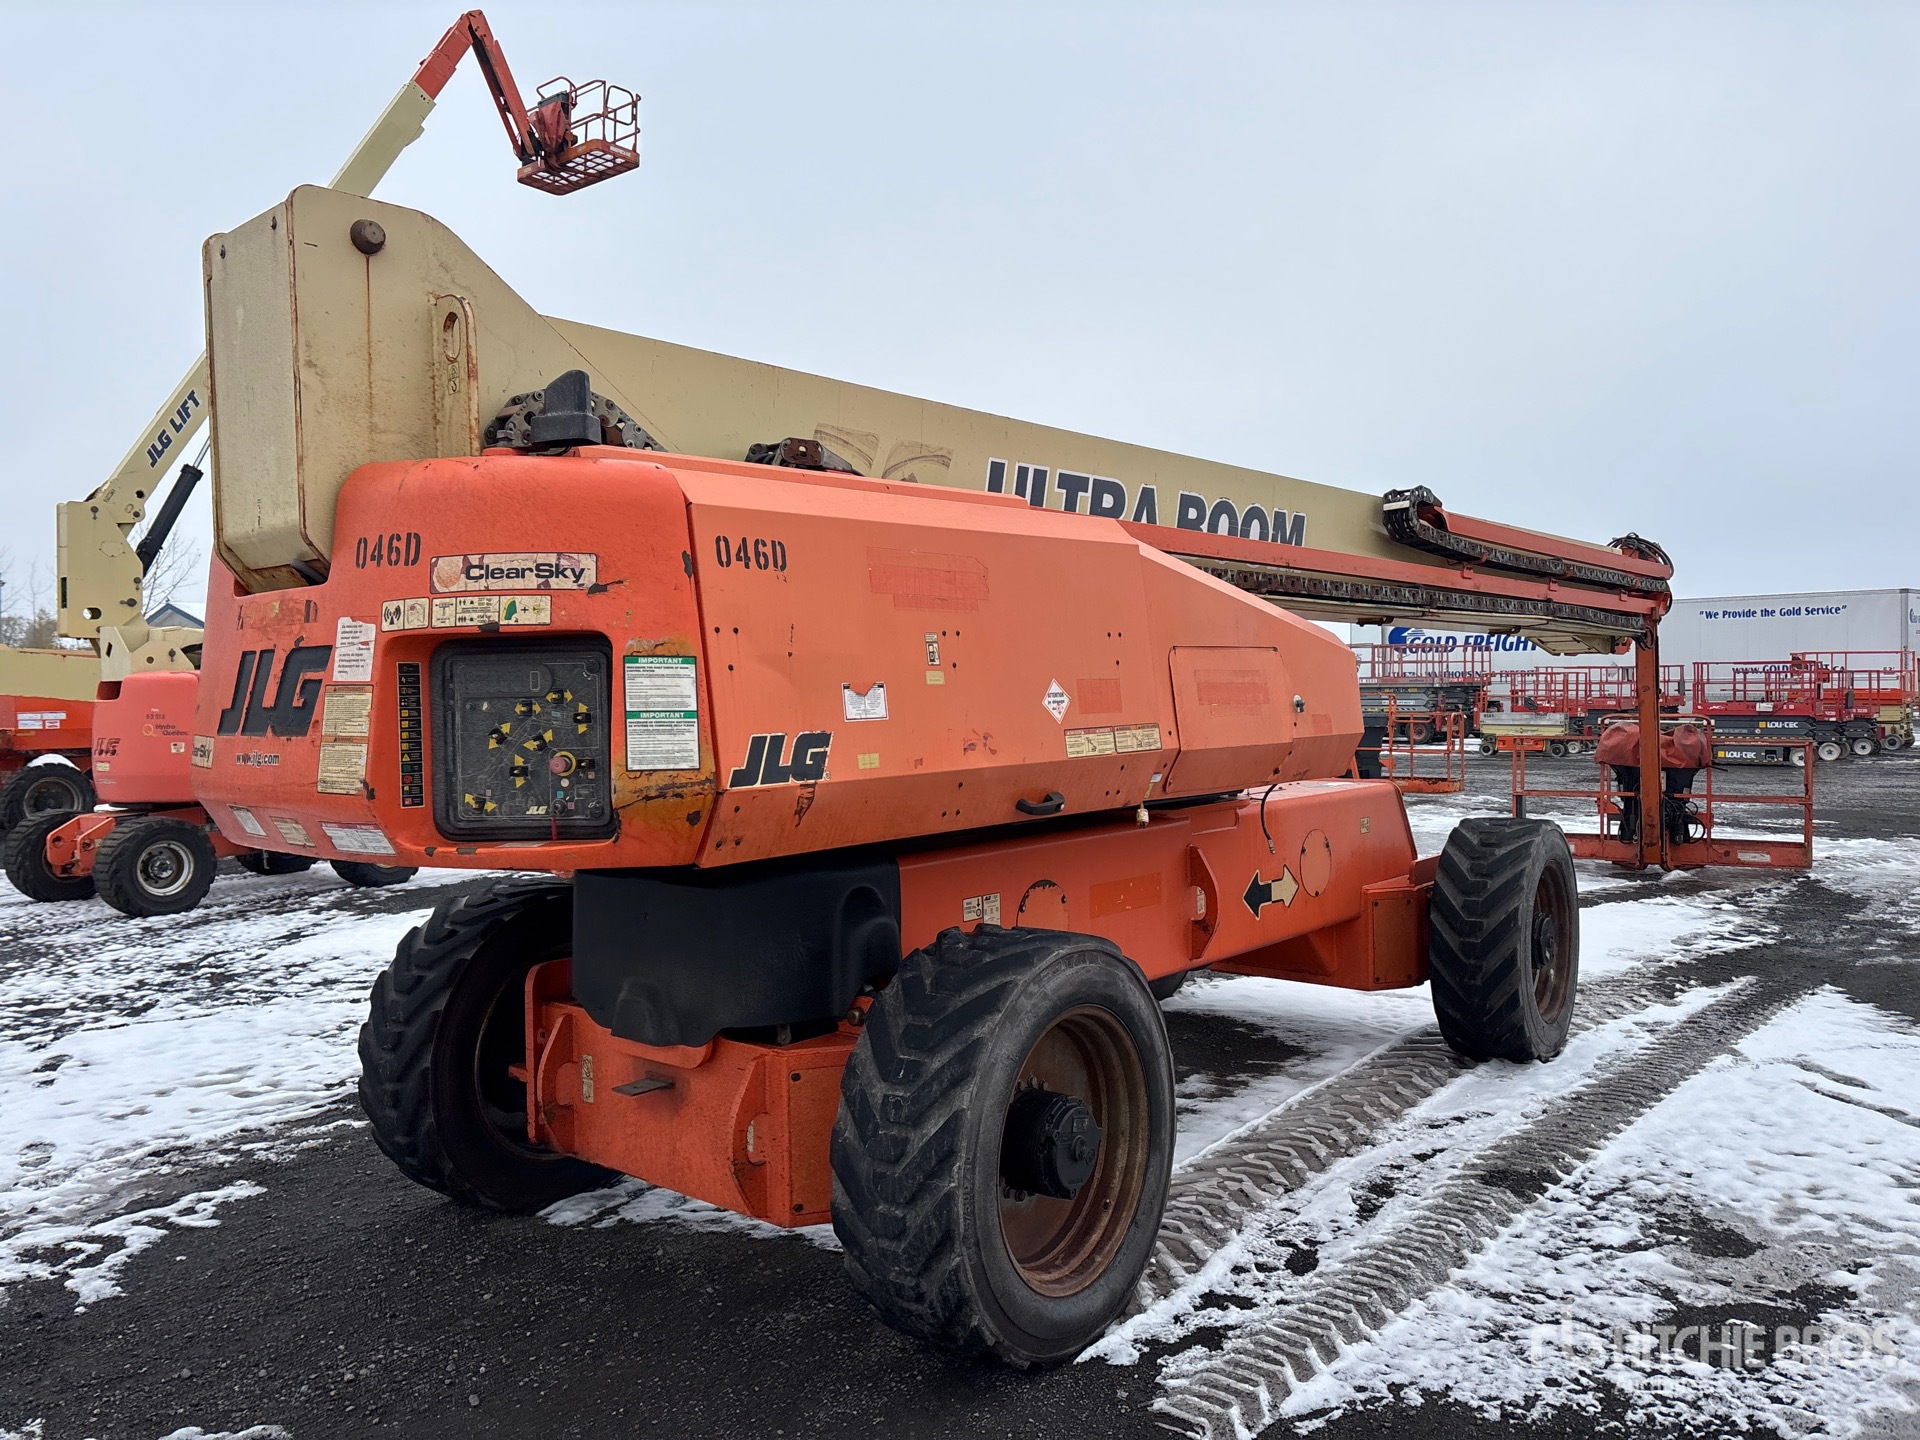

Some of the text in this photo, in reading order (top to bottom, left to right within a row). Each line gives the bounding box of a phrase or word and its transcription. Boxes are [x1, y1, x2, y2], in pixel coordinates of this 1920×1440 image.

[146, 389, 200, 468] JLG LIFT
[1177, 490, 1306, 547] BOOM
[355, 532, 421, 569] 046D
[715, 535, 787, 572] 046D
[465, 562, 585, 583] ClearSky
[1722, 608, 1757, 619] Provide
[1760, 607, 1776, 618] the
[1779, 606, 1801, 617] Gold
[217, 645, 333, 737] JLG
[236, 750, 280, 767] www.jlg.com
[728, 731, 833, 789] JLG
[525, 805, 548, 815] JLG
